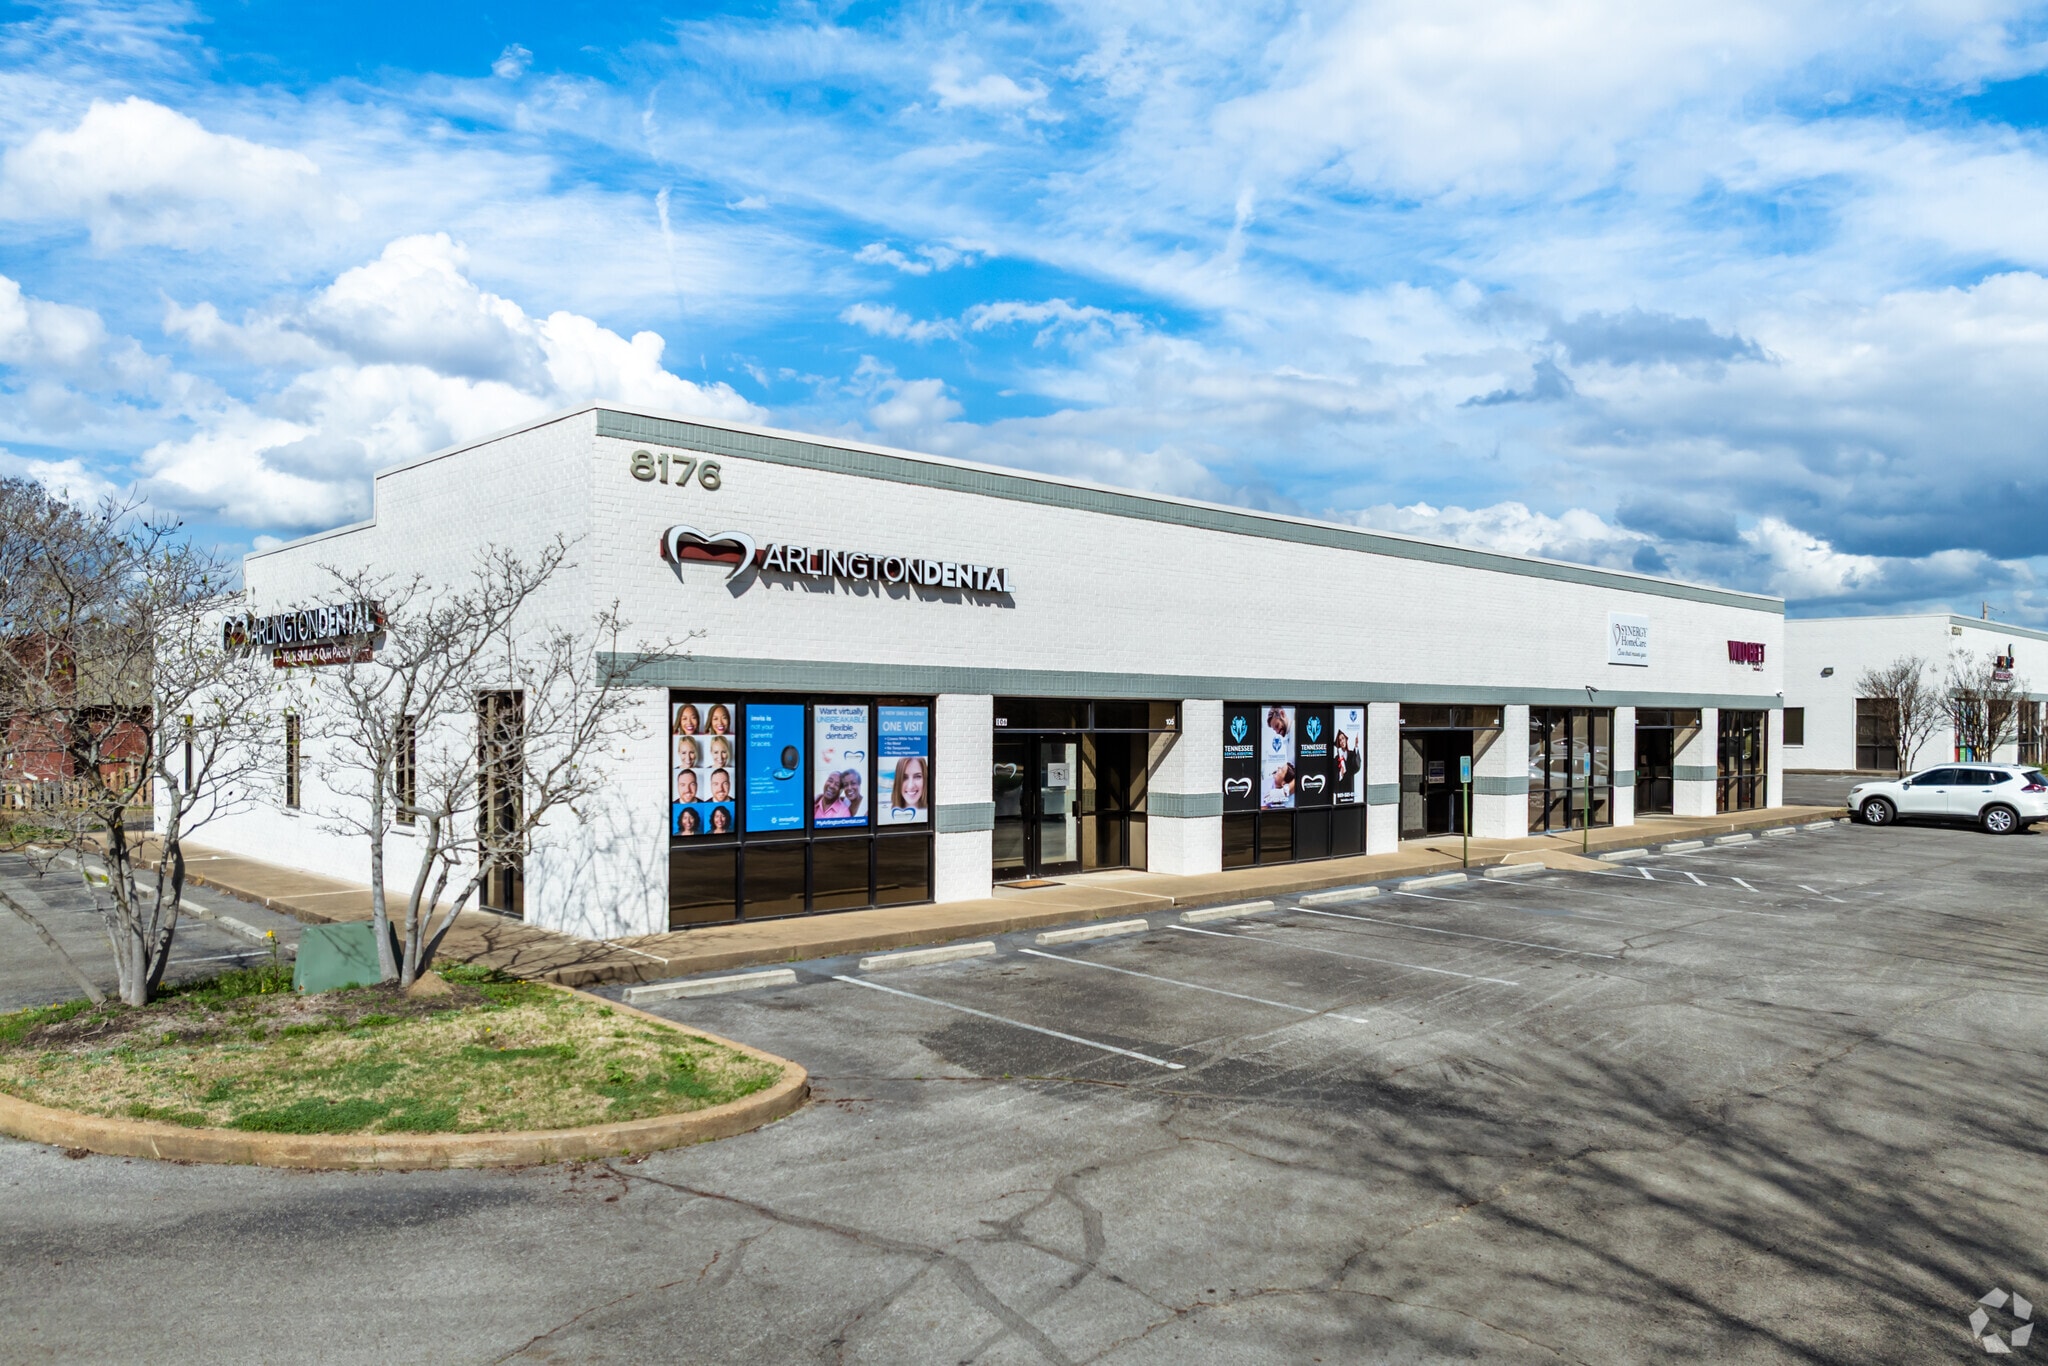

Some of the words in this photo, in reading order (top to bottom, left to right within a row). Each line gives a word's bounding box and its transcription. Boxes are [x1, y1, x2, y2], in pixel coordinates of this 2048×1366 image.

[630, 449, 721, 490] 8176
[1621, 625, 1648, 637] SYNERGY
[839, 708, 864, 716] virtually
[882, 721, 901, 731] ONE
[904, 721, 924, 731] VISIT
